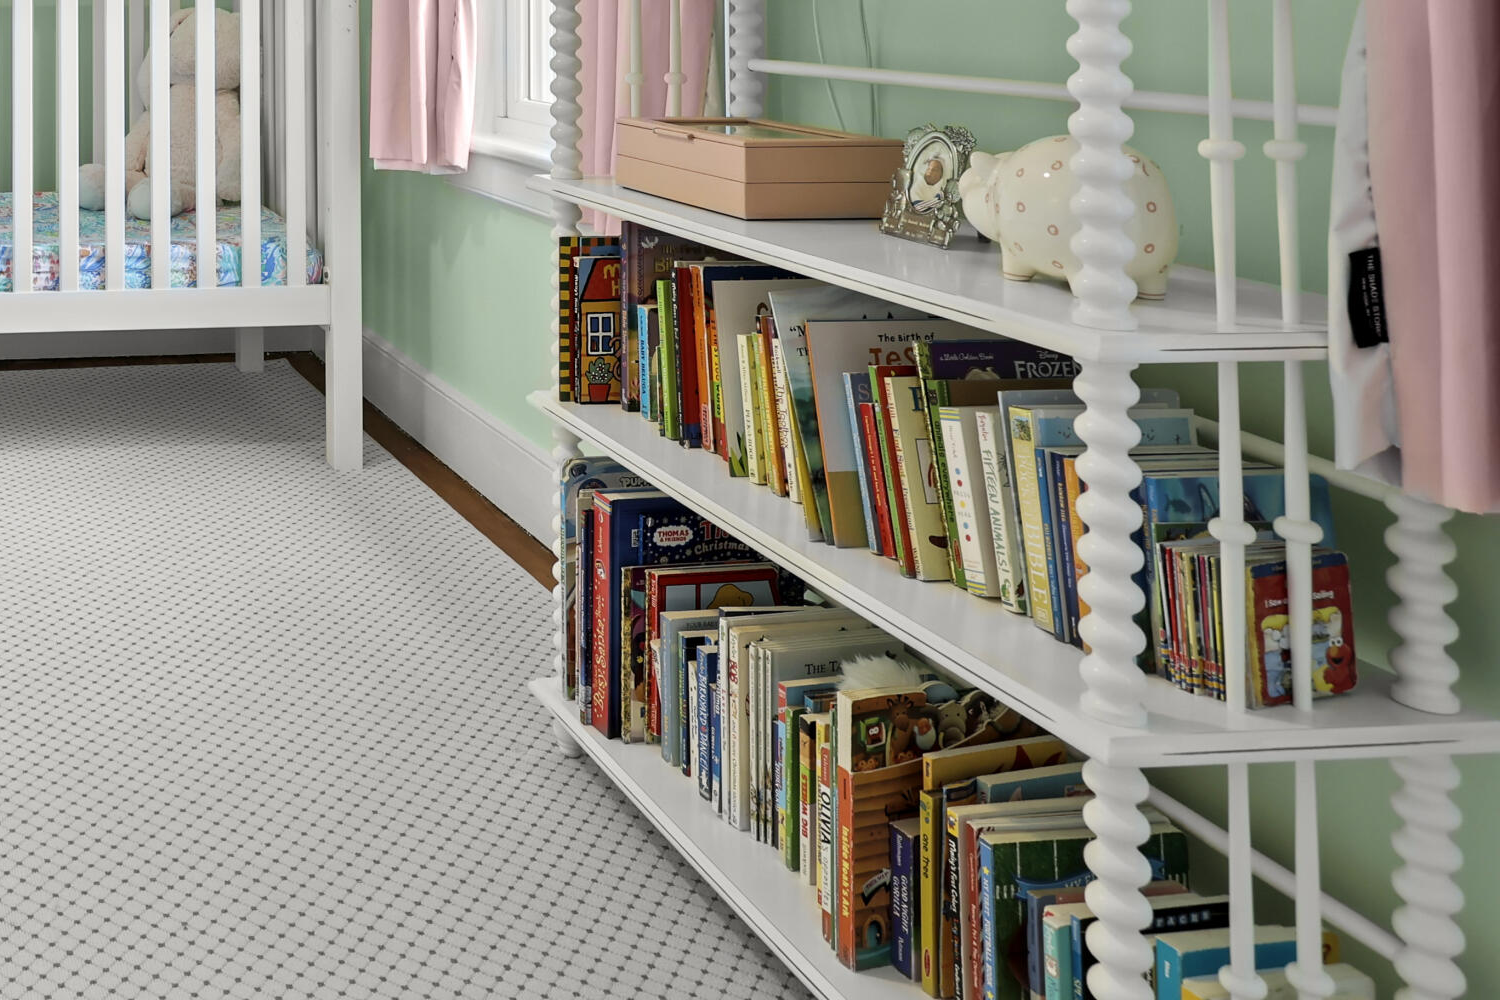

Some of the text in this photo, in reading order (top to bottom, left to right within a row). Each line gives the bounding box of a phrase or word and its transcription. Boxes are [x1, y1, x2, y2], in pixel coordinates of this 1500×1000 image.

[1367, 255, 1375, 271] THE
[1368, 274, 1378, 303] SHADE
[878, 333, 895, 343] The
[898, 333, 922, 342] Birth
[640, 362, 648, 394] BELUGA
[774, 345, 789, 449] Rockwell The Toolbox
[887, 402, 896, 418] Hill
[892, 429, 902, 452] Find
[896, 454, 906, 479] Spot
[934, 420, 946, 458] animals
[940, 462, 956, 523] everywhere
[982, 450, 999, 504] FIFTEEN
[657, 530, 689, 538] THOMAS
[990, 508, 1010, 574] ANIMALS!
[912, 547, 922, 576] WARNE
[1026, 521, 1048, 604] BIBLE
[729, 659, 739, 684] BOB
[805, 663, 826, 675] THE
[699, 673, 708, 725] BARNYARD
[699, 733, 709, 769] DANCE!
[801, 773, 809, 838] BIG WHEELS
[923, 855, 931, 879] tree
[948, 839, 958, 871] Maisy's
[822, 856, 831, 907] opposites
[841, 825, 851, 917] Inside Noah's Ark
[949, 872, 957, 889] First
[983, 878, 989, 890] MY
[892, 875, 900, 917] GORILLA
[900, 875, 909, 900] GOOD
[949, 889, 958, 913] Colors
[984, 918, 992, 961] FOOTBALL
